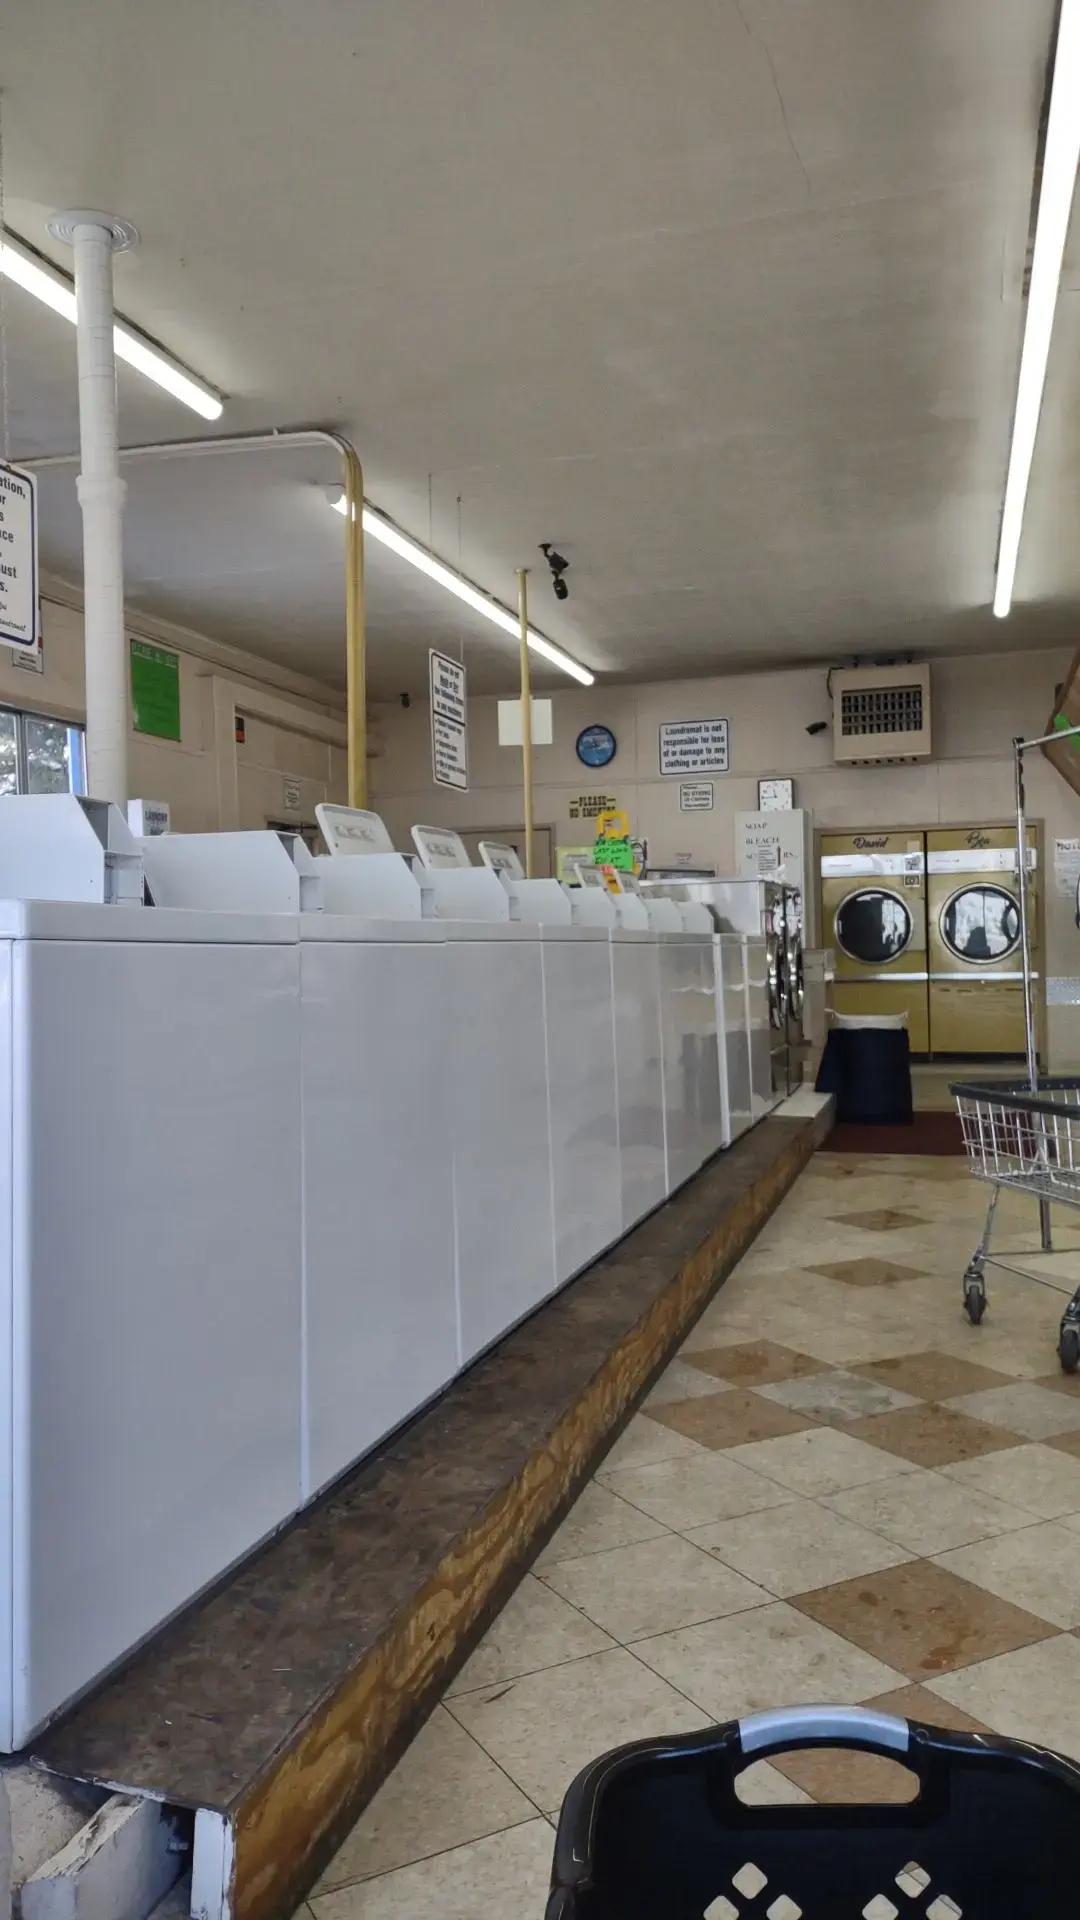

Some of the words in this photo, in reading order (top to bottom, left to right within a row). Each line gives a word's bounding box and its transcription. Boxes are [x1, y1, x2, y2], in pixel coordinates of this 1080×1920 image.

[711, 724, 722, 732] not
[663, 736, 698, 747] responsible
[700, 736, 709, 744] for
[679, 748, 704, 756] damage
[664, 759, 690, 768] clothing
[700, 757, 724, 766] articles
[569, 808, 579, 818] NO
[745, 822, 768, 830] SOAP
[745, 837, 780, 845] BLEACH
[853, 836, 889, 849] David
